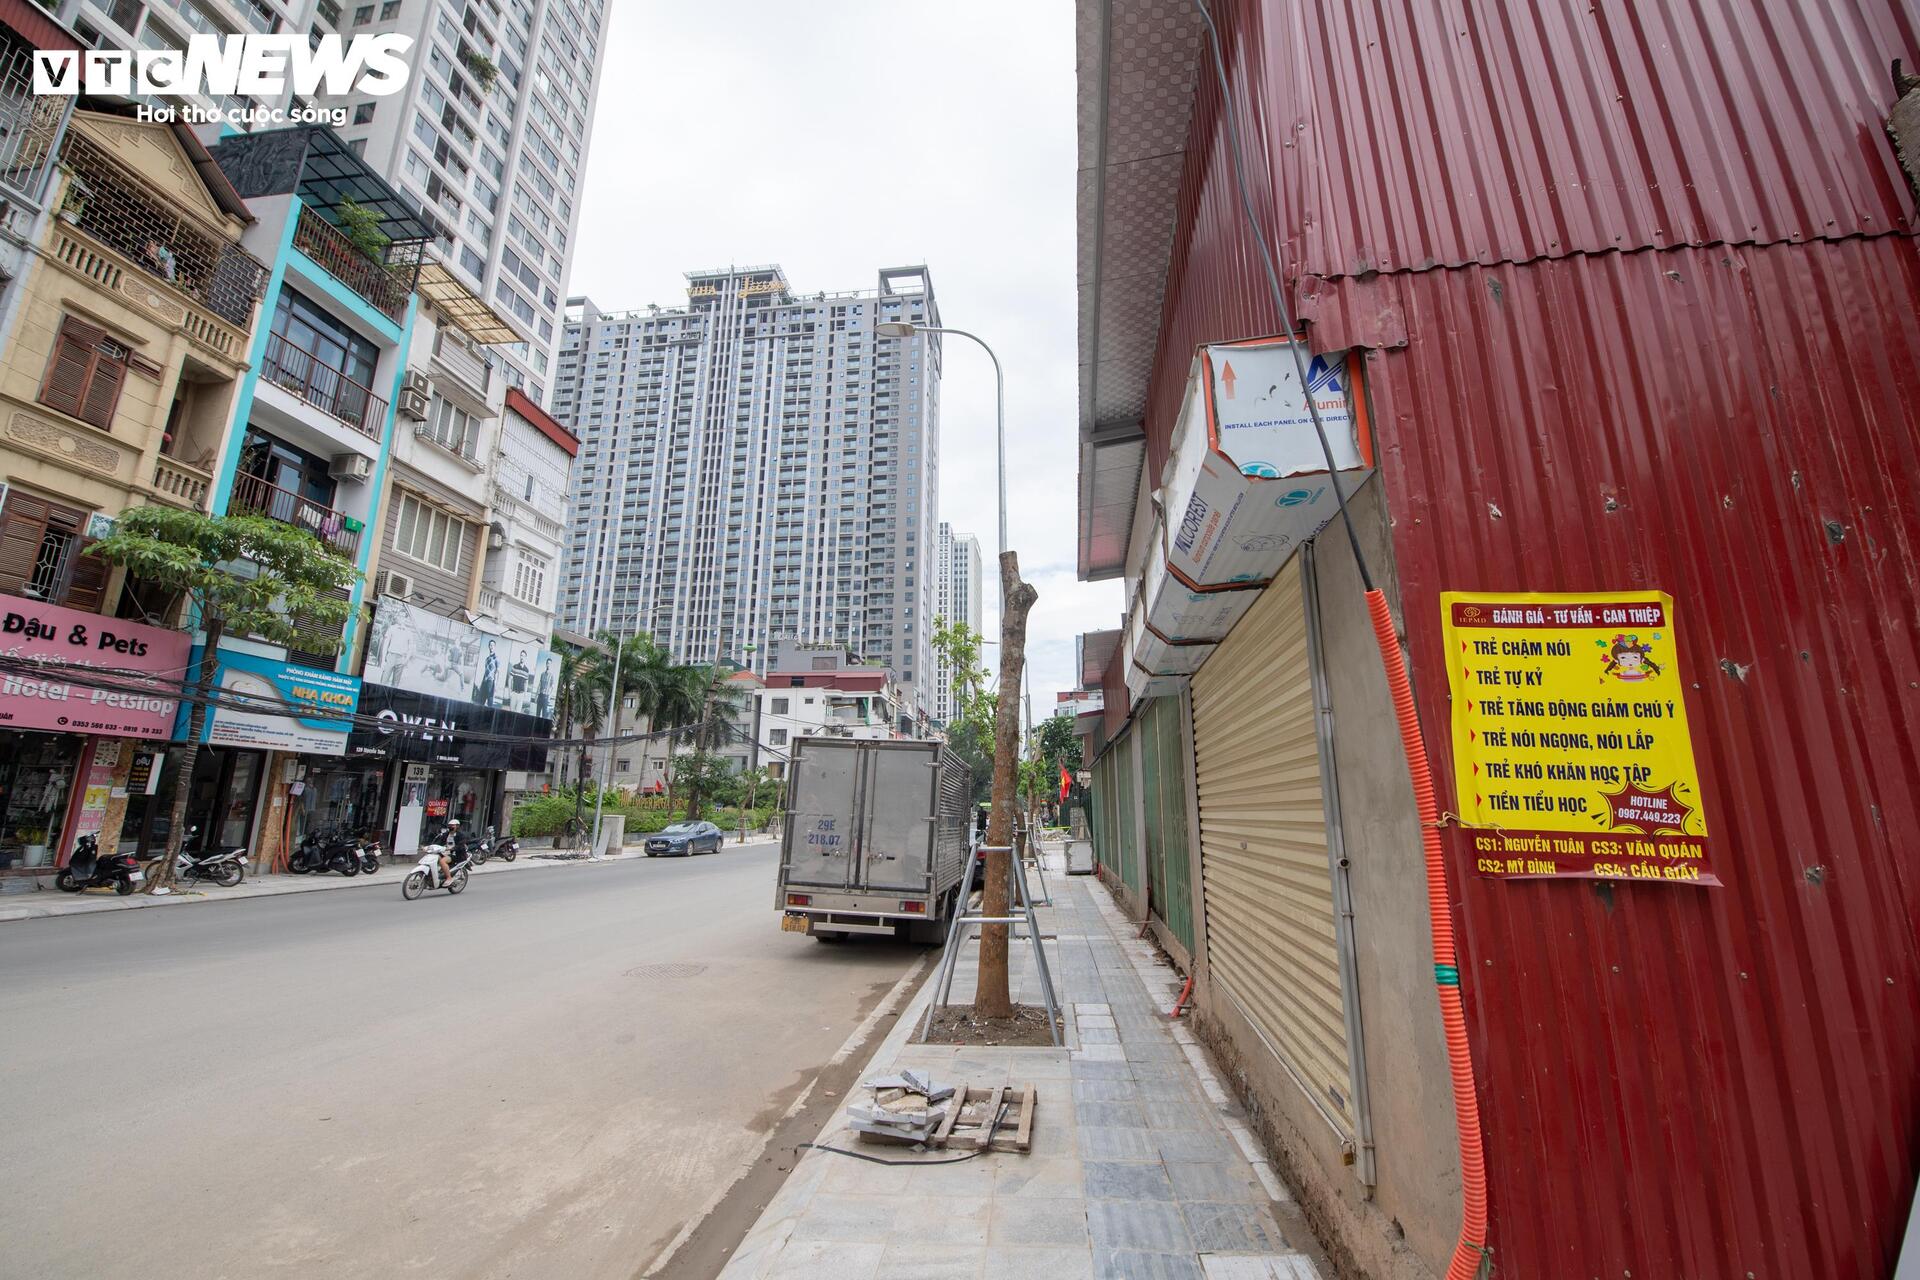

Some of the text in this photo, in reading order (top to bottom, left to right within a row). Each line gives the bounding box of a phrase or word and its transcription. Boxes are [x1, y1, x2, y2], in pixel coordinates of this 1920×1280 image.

[1224, 421, 1252, 430] INSTALL
[1254, 419, 1272, 427] EACH
[1274, 418, 1297, 426] PANEL
[1492, 607, 1523, 624] ĐÁNH
[1525, 608, 1545, 624] GIÁ
[1553, 609, 1570, 624] TƯ
[1570, 608, 1593, 624] VẤN
[1602, 609, 1627, 624] CAN
[1628, 607, 1661, 626] THIỆP
[2, 612, 149, 657] Đậu & Pets
[1473, 636, 1571, 659] TRẺ CHẬM NÓI
[1476, 666, 1543, 688] TRẺ TỰ KỶ
[2, 674, 70, 701] Hotel
[91, 687, 174, 717] Petshop
[292, 685, 354, 706] NHA KHOA
[1479, 696, 1675, 721] TRẺ TĂNG ĐỘNG GIẢM CHÚ Ý
[376, 709, 456, 742] OWEN
[1482, 727, 1654, 752] TRẺ NÓI NGỌNG, NÓI LẮP
[412, 767, 425, 776] 139
[1485, 758, 1652, 785] TRẺ KHÓ KHĂN HỌC TẬP
[1523, 789, 1554, 811] TIỂU
[1557, 797, 1588, 816] HỌC
[1630, 795, 1668, 810] HOTLINE
[1618, 808, 1681, 824] 0987.449.223
[1476, 834, 1585, 854] CS1: NGUYỄN TUÂN
[1591, 840, 1703, 860] CS3: VĂN QUÁN
[1478, 858, 1556, 874] CS2: MỸ ĐÌNH
[1593, 860, 1699, 880] CS4: CẦU GIẤY
